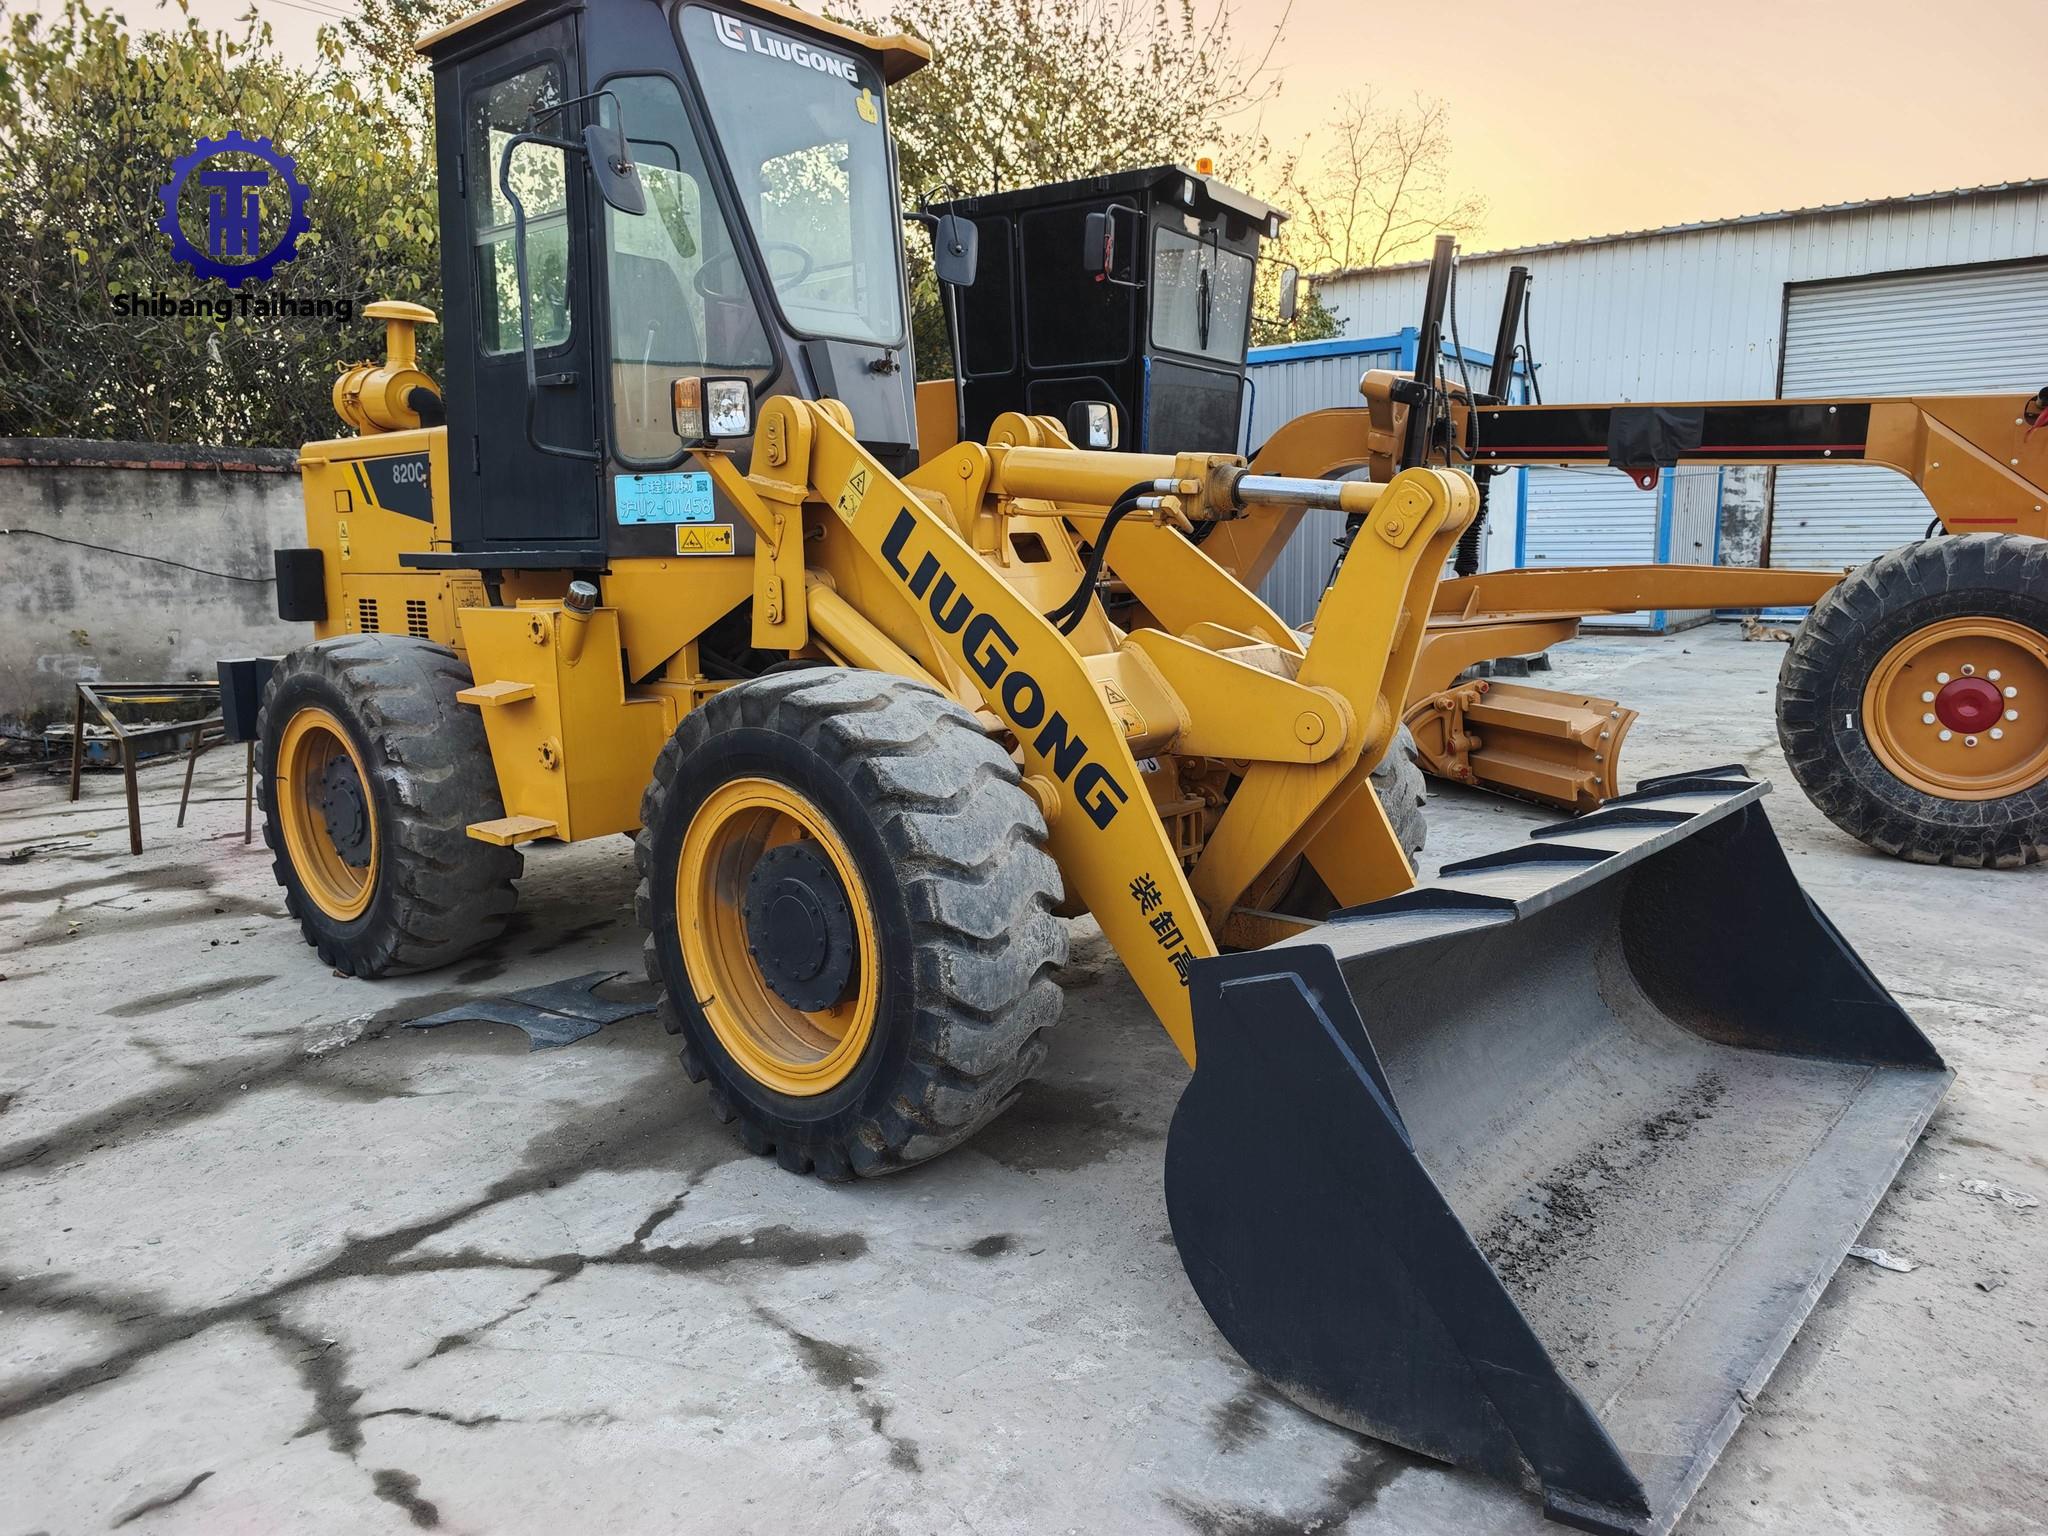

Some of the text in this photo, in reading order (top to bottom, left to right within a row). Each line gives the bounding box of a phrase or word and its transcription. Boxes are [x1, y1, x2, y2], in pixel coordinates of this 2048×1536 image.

[392, 461, 425, 484] 820C
[635, 479, 694, 495] 工程机械
[620, 497, 712, 519] 沪U2-01458
[881, 506, 1129, 831] LIUGONG
